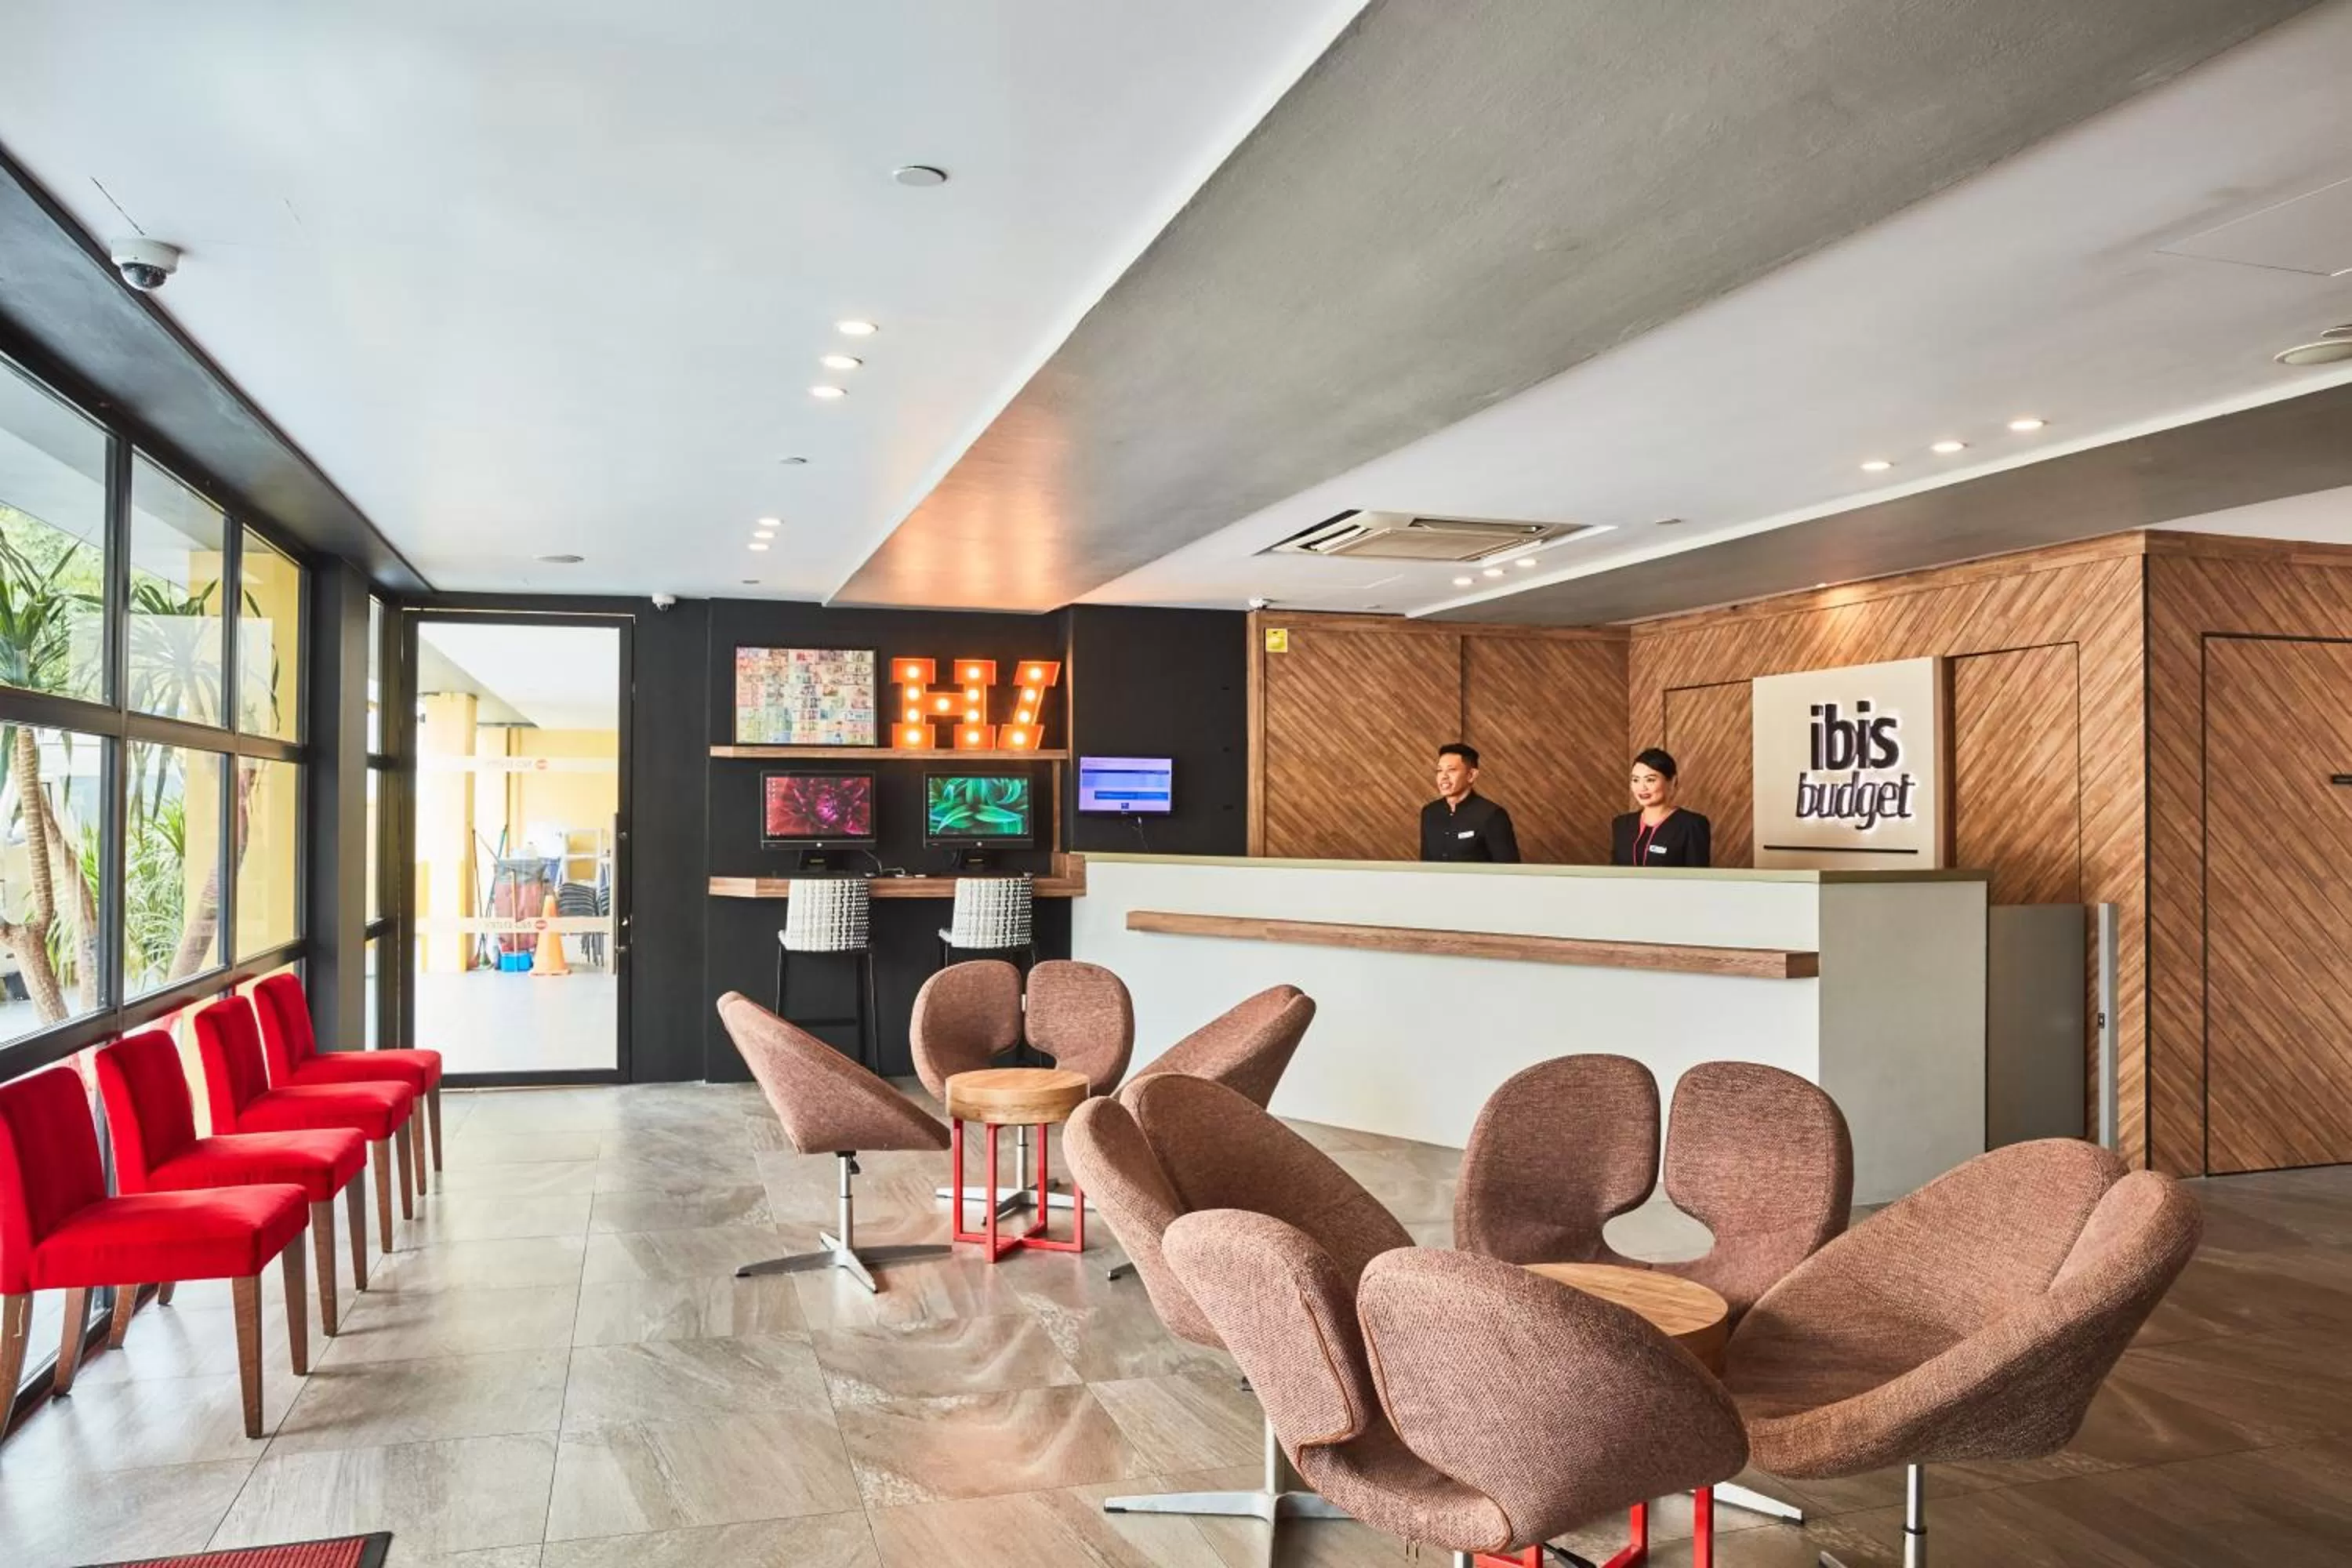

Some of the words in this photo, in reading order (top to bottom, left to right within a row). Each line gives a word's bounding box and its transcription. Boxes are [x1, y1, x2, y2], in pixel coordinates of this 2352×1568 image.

[891, 657, 1061, 750] HI
[1810, 700, 1900, 771] ibis
[1795, 771, 1915, 830] budget
